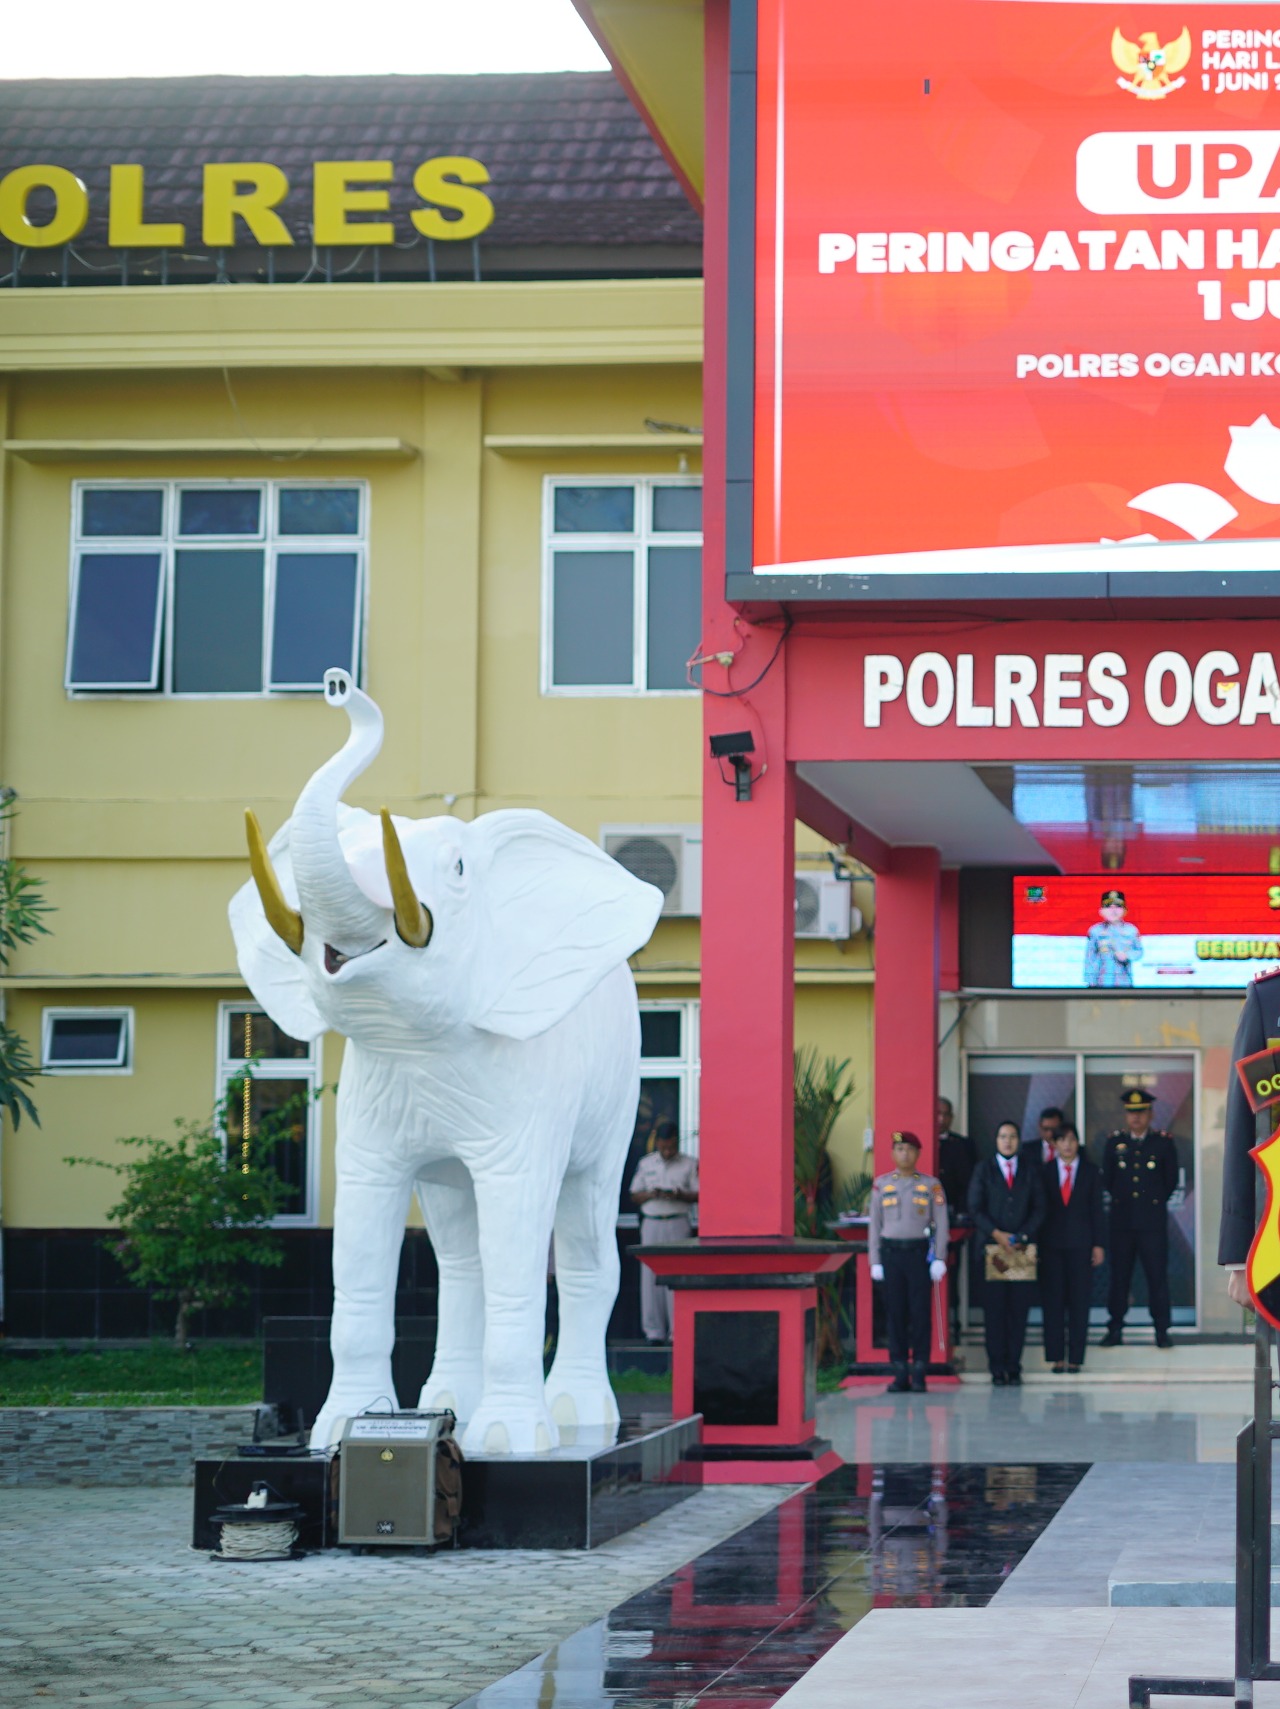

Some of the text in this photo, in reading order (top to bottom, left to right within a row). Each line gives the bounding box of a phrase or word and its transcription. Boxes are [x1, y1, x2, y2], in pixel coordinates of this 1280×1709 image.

[1202, 51, 1258, 70] HARI
[1201, 73, 1210, 91] 1
[1215, 72, 1268, 94] JUNI
[0, 155, 495, 247] OLRES
[819, 229, 1204, 273] PERINGATAN
[1198, 280, 1221, 320] 1
[1016, 353, 1139, 378] POLRES
[1144, 352, 1245, 377] OGAN
[863, 651, 1130, 728] POLRES
